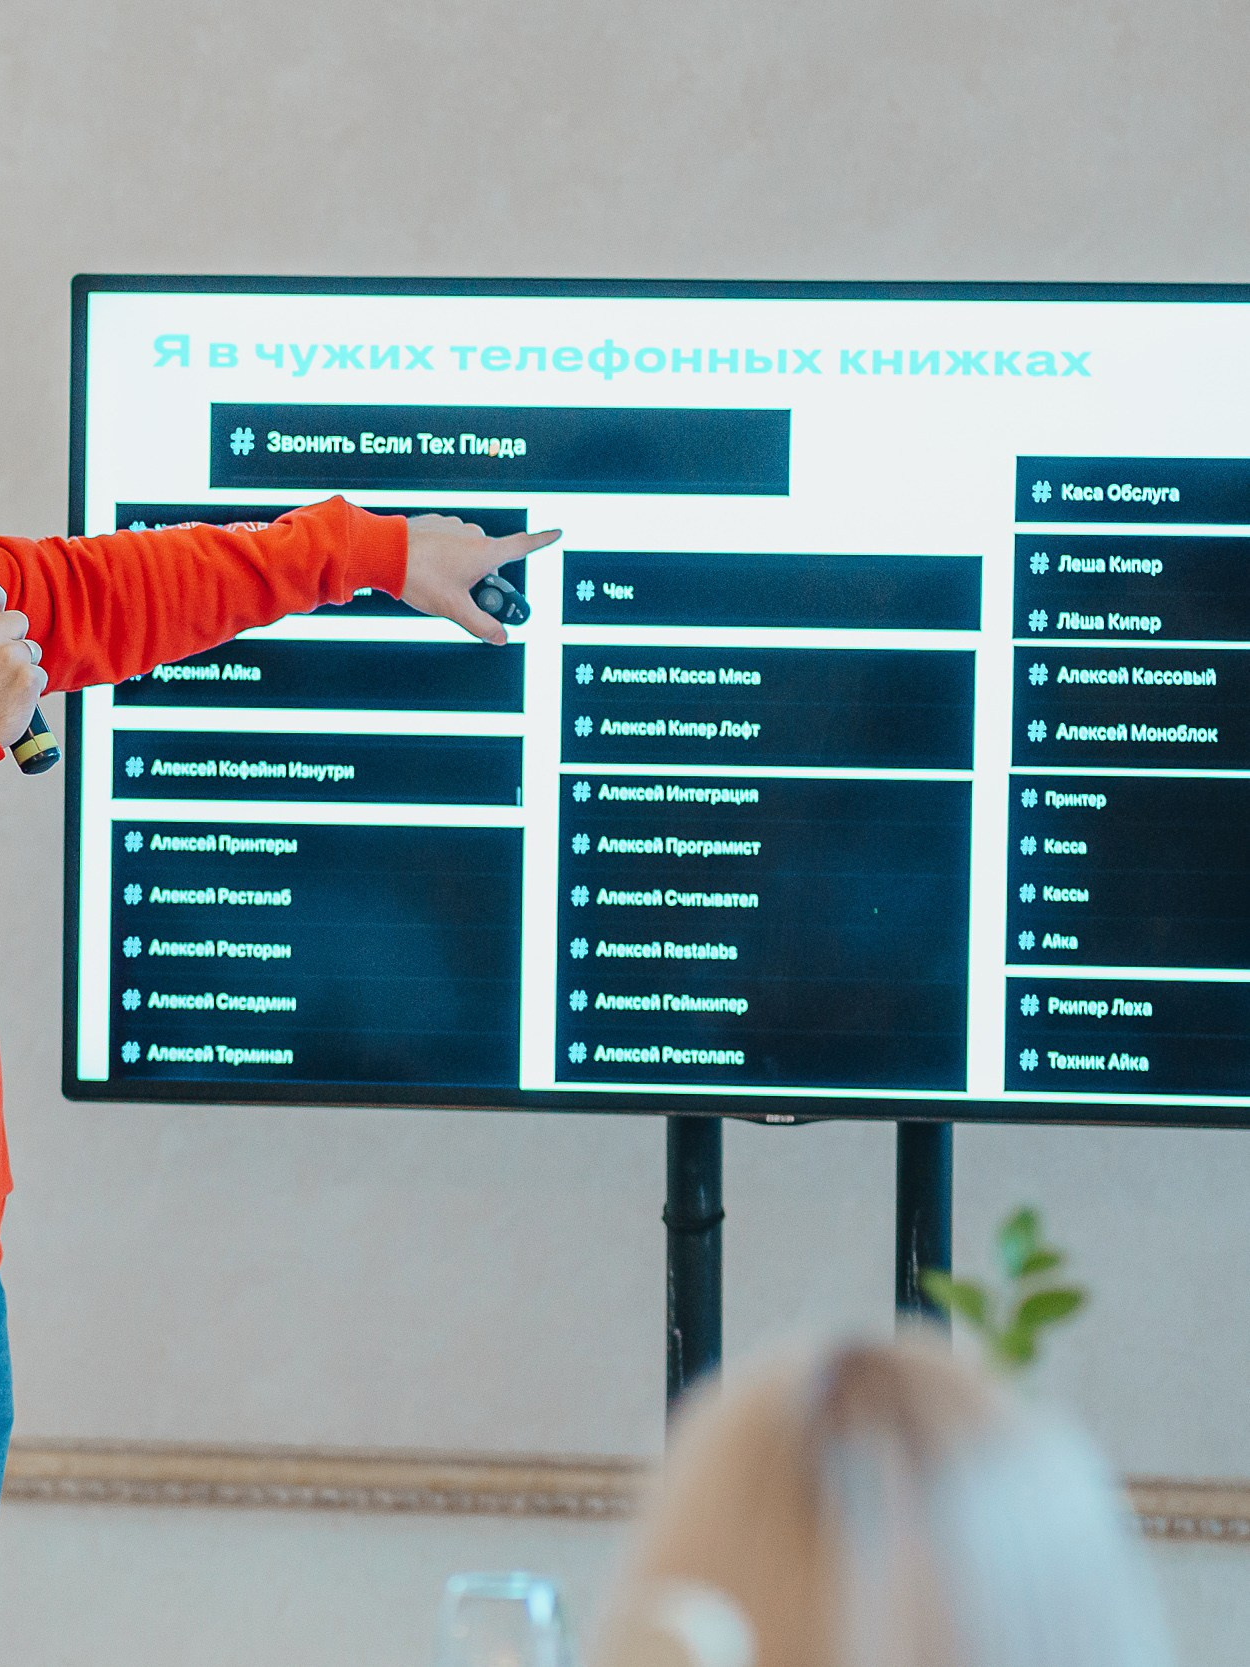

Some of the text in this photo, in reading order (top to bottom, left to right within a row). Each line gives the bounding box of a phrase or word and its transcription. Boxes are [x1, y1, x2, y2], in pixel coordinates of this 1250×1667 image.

[153, 333, 1092, 381] Я в чужих телефонных книжках
[266, 430, 356, 454] Звонить
[359, 431, 413, 455] Если
[416, 432, 456, 455] Тех
[1061, 483, 1104, 502] Каса
[1106, 483, 1181, 506] Обслуга
[1057, 554, 1106, 573] Леша
[1108, 555, 1163, 577] Кипер
[602, 582, 635, 600] Чек
[1107, 612, 1162, 635] Кипер
[151, 663, 262, 683] Арсений Айка
[600, 665, 668, 684] Алексей
[669, 666, 717, 685] Касса
[718, 667, 762, 686] Мяса
[1056, 665, 1129, 685] Алексей
[1131, 666, 1217, 686] Кассовый
[599, 718, 667, 737] Алексей
[667, 719, 718, 740] Кипер
[718, 719, 762, 741] Лофт
[1055, 722, 1128, 742] Алексей
[1130, 723, 1219, 743] Моноблок
[150, 758, 218, 777] Алексей
[218, 760, 287, 781] Кофейня
[288, 761, 355, 782] Изнутри
[597, 783, 665, 802] Алексей
[666, 784, 759, 806] Интеграция
[1044, 790, 1107, 810] Принтер
[149, 833, 217, 852] Алексей
[217, 834, 298, 856] Принтеры
[597, 835, 664, 854] Алексей
[1043, 837, 1088, 855] Касса
[148, 886, 217, 905] Алексей
[217, 887, 292, 907] Ресталаб
[596, 887, 663, 907] Алексей
[1042, 885, 1090, 903] Кассы
[148, 938, 216, 958] Алексей
[216, 939, 292, 961] Ресторан
[595, 940, 662, 959] Алексей
[663, 941, 739, 961] Restalabs
[1041, 932, 1079, 950] Айка
[147, 991, 215, 1010] Алексей
[215, 992, 297, 1014] Сисадмин
[594, 992, 661, 1011] Алексей
[1047, 996, 1109, 1019] Ркипер
[1110, 997, 1153, 1017] Леха
[146, 1043, 215, 1063] Алексей
[214, 1044, 294, 1067] Терминал
[593, 1044, 661, 1063] Алексей
[1047, 1051, 1106, 1071] Техник
[1107, 1052, 1150, 1072] Айка
